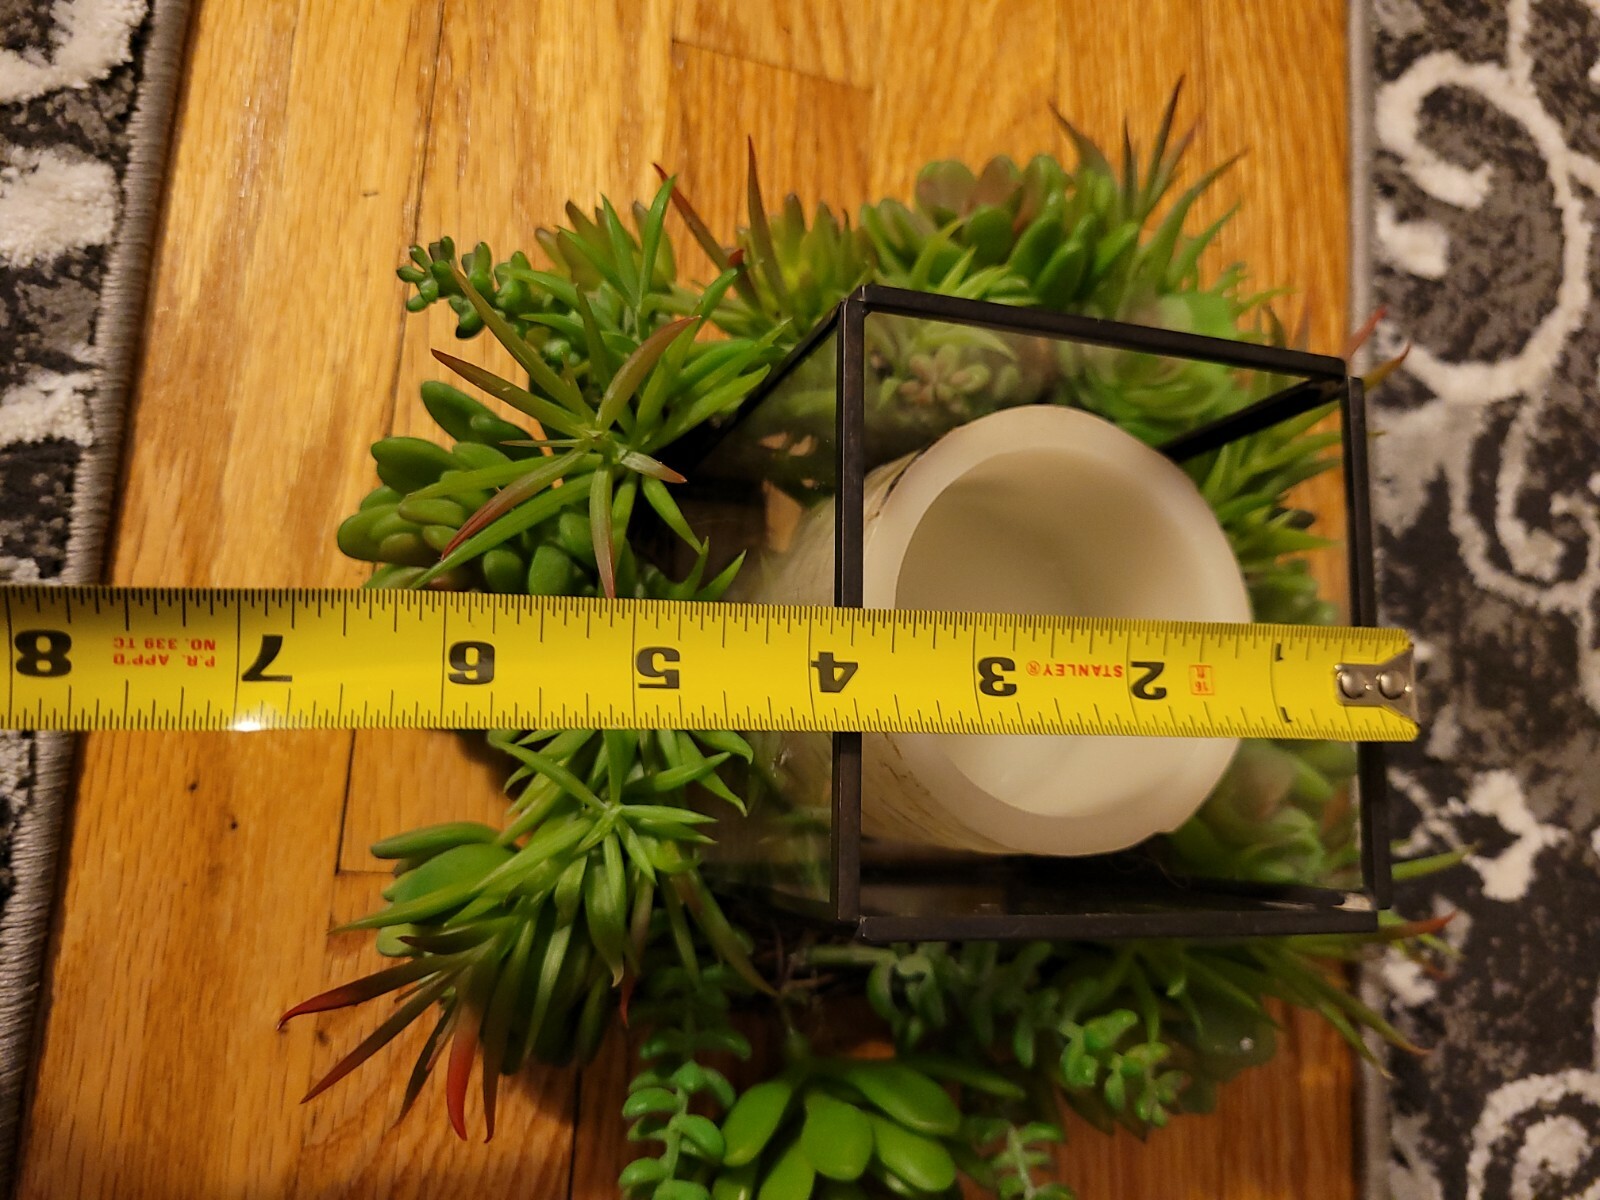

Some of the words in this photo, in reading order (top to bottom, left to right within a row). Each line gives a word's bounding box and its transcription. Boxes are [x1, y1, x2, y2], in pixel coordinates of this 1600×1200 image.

[14, 629, 72, 678] 8
[113, 636, 136, 649] TC
[144, 637, 178, 650] 339
[241, 634, 293, 682] 7
[448, 640, 496, 685] 6
[635, 645, 681, 690] 5
[811, 651, 859, 694] 4
[977, 656, 1018, 697] 3
[1130, 661, 1167, 700] 2
